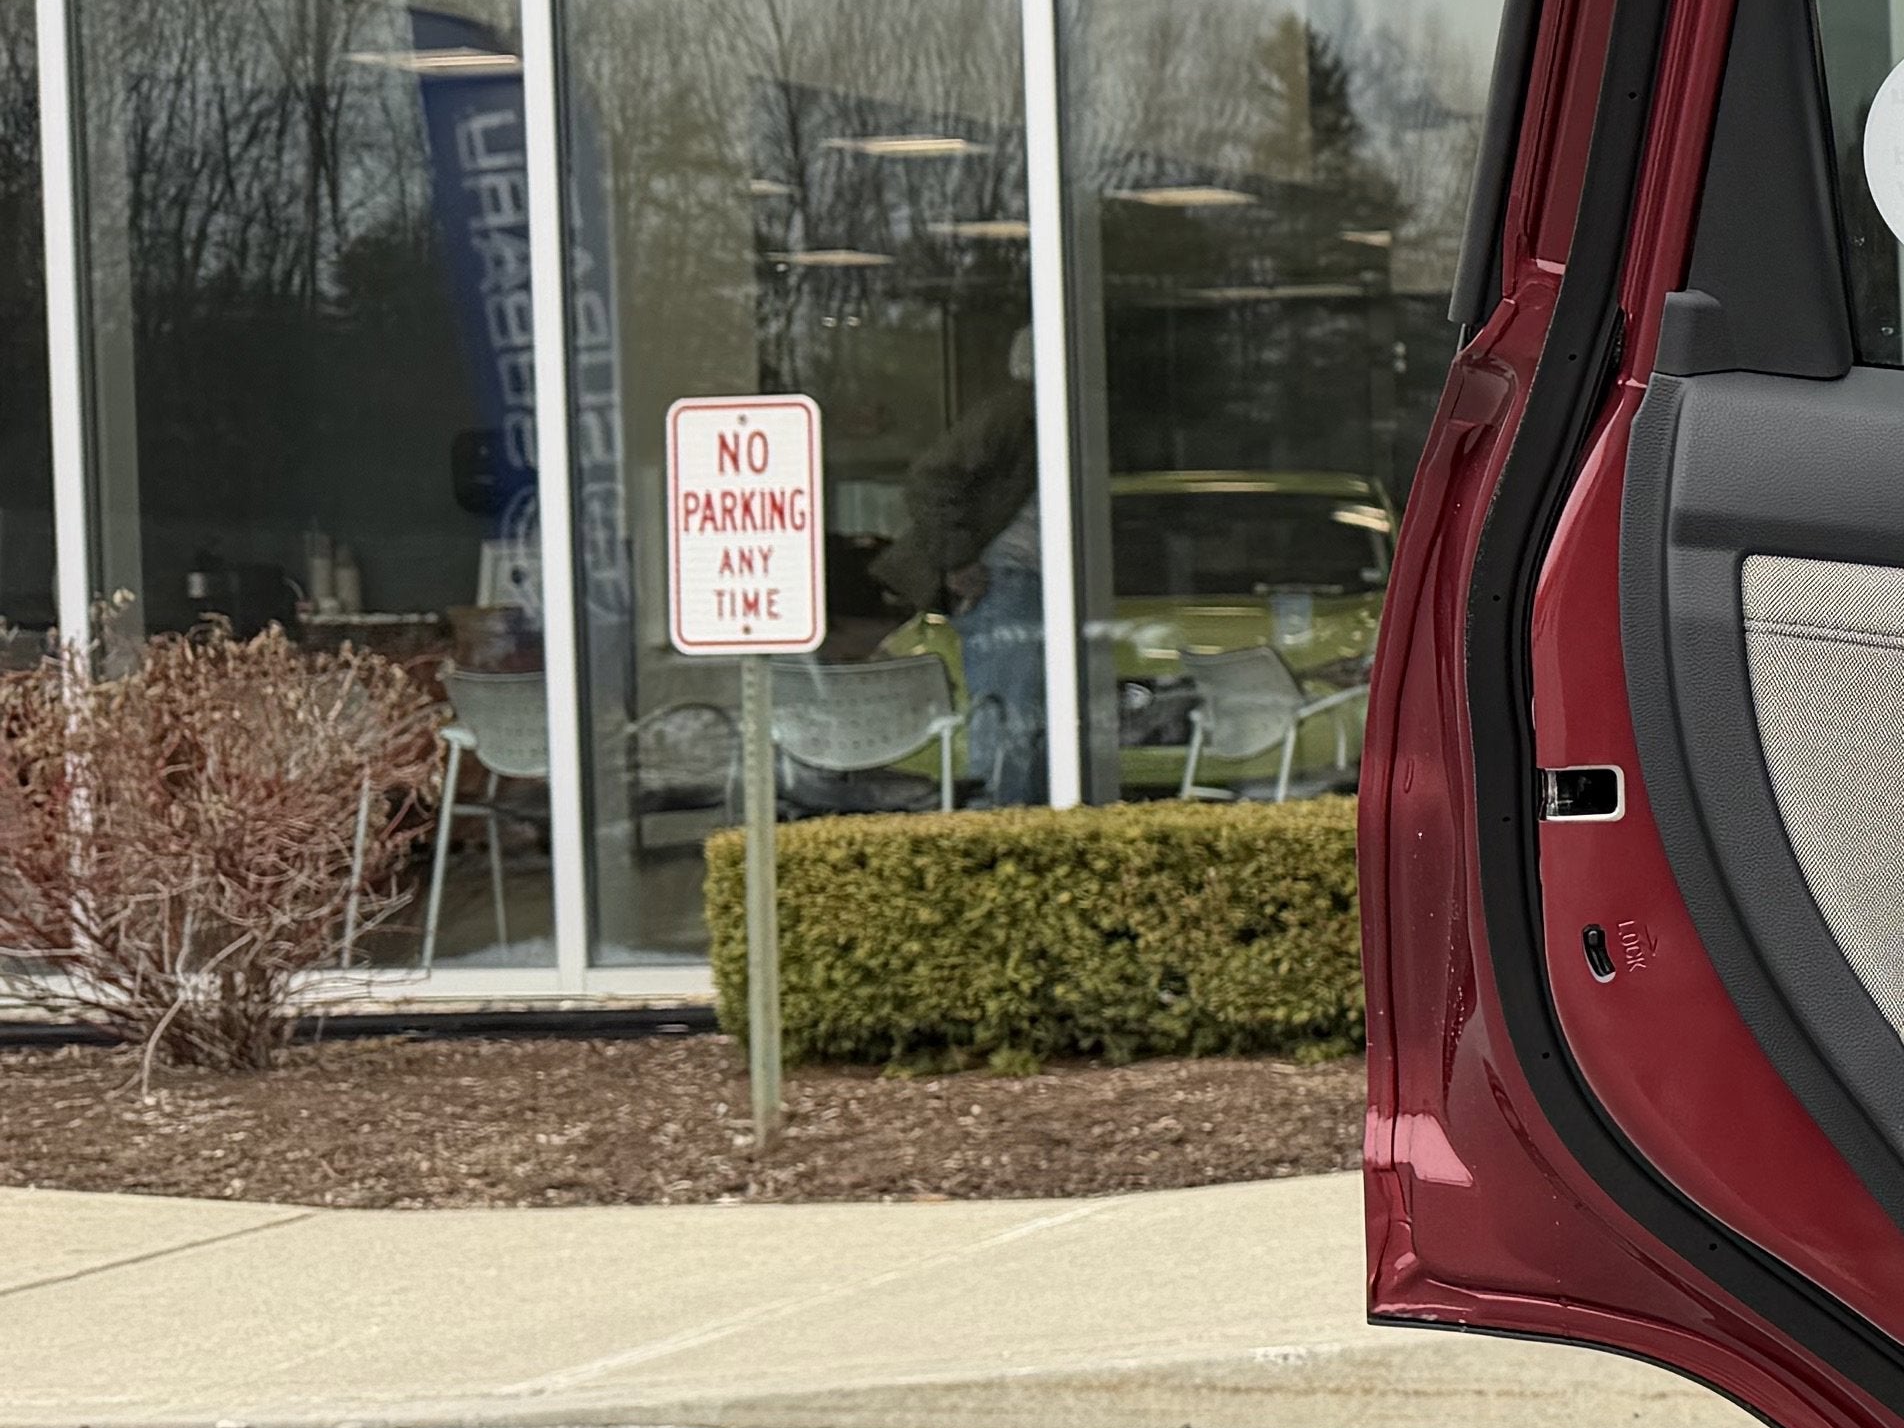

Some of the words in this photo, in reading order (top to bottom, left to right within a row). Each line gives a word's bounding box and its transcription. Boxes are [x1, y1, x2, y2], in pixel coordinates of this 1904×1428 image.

[717, 430, 769, 476] NO
[683, 489, 806, 533] PARKING
[719, 546, 774, 576] ANY
[714, 588, 781, 620] TIME
[1617, 919, 1648, 973] LOCK
